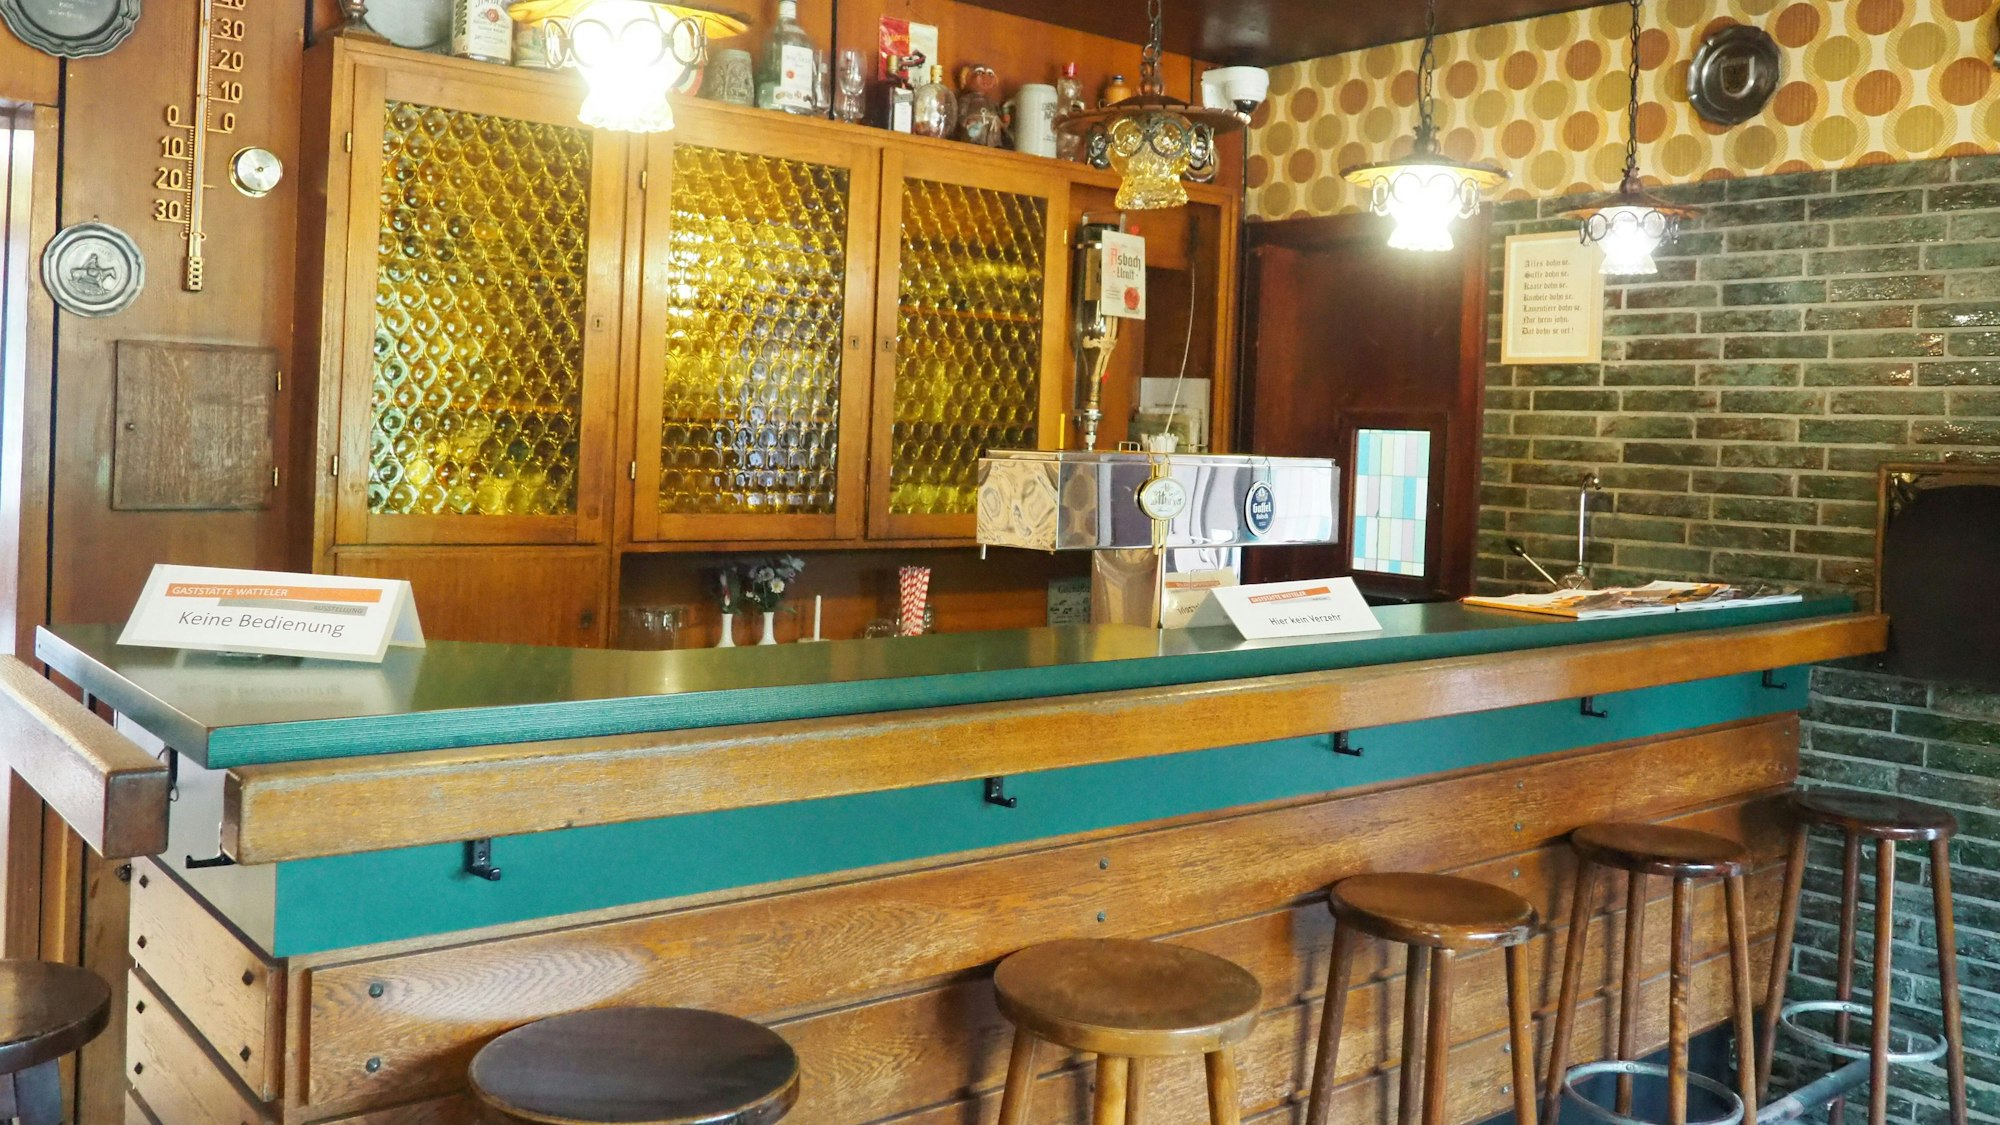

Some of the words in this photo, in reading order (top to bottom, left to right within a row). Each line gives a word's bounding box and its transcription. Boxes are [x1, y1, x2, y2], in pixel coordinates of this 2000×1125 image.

[219, 18, 245, 39] 30
[218, 49, 244, 71] 20
[221, 80, 242, 102] 10
[167, 104, 179, 124] 0
[224, 112, 235, 132] 0
[161, 135, 184, 157] 10
[155, 166, 183, 188] 20
[154, 198, 181, 220] 30
[1110, 247, 1141, 271] Asbach
[172, 585, 233, 596] GASTSTÄTTE
[236, 587, 288, 597] WATTELER
[178, 610, 233, 627] Keine
[238, 613, 345, 638] Bedienung
[1269, 616, 1289, 626] Hier
[1288, 615, 1309, 625] kein
[1309, 612, 1342, 624] Verzehr
